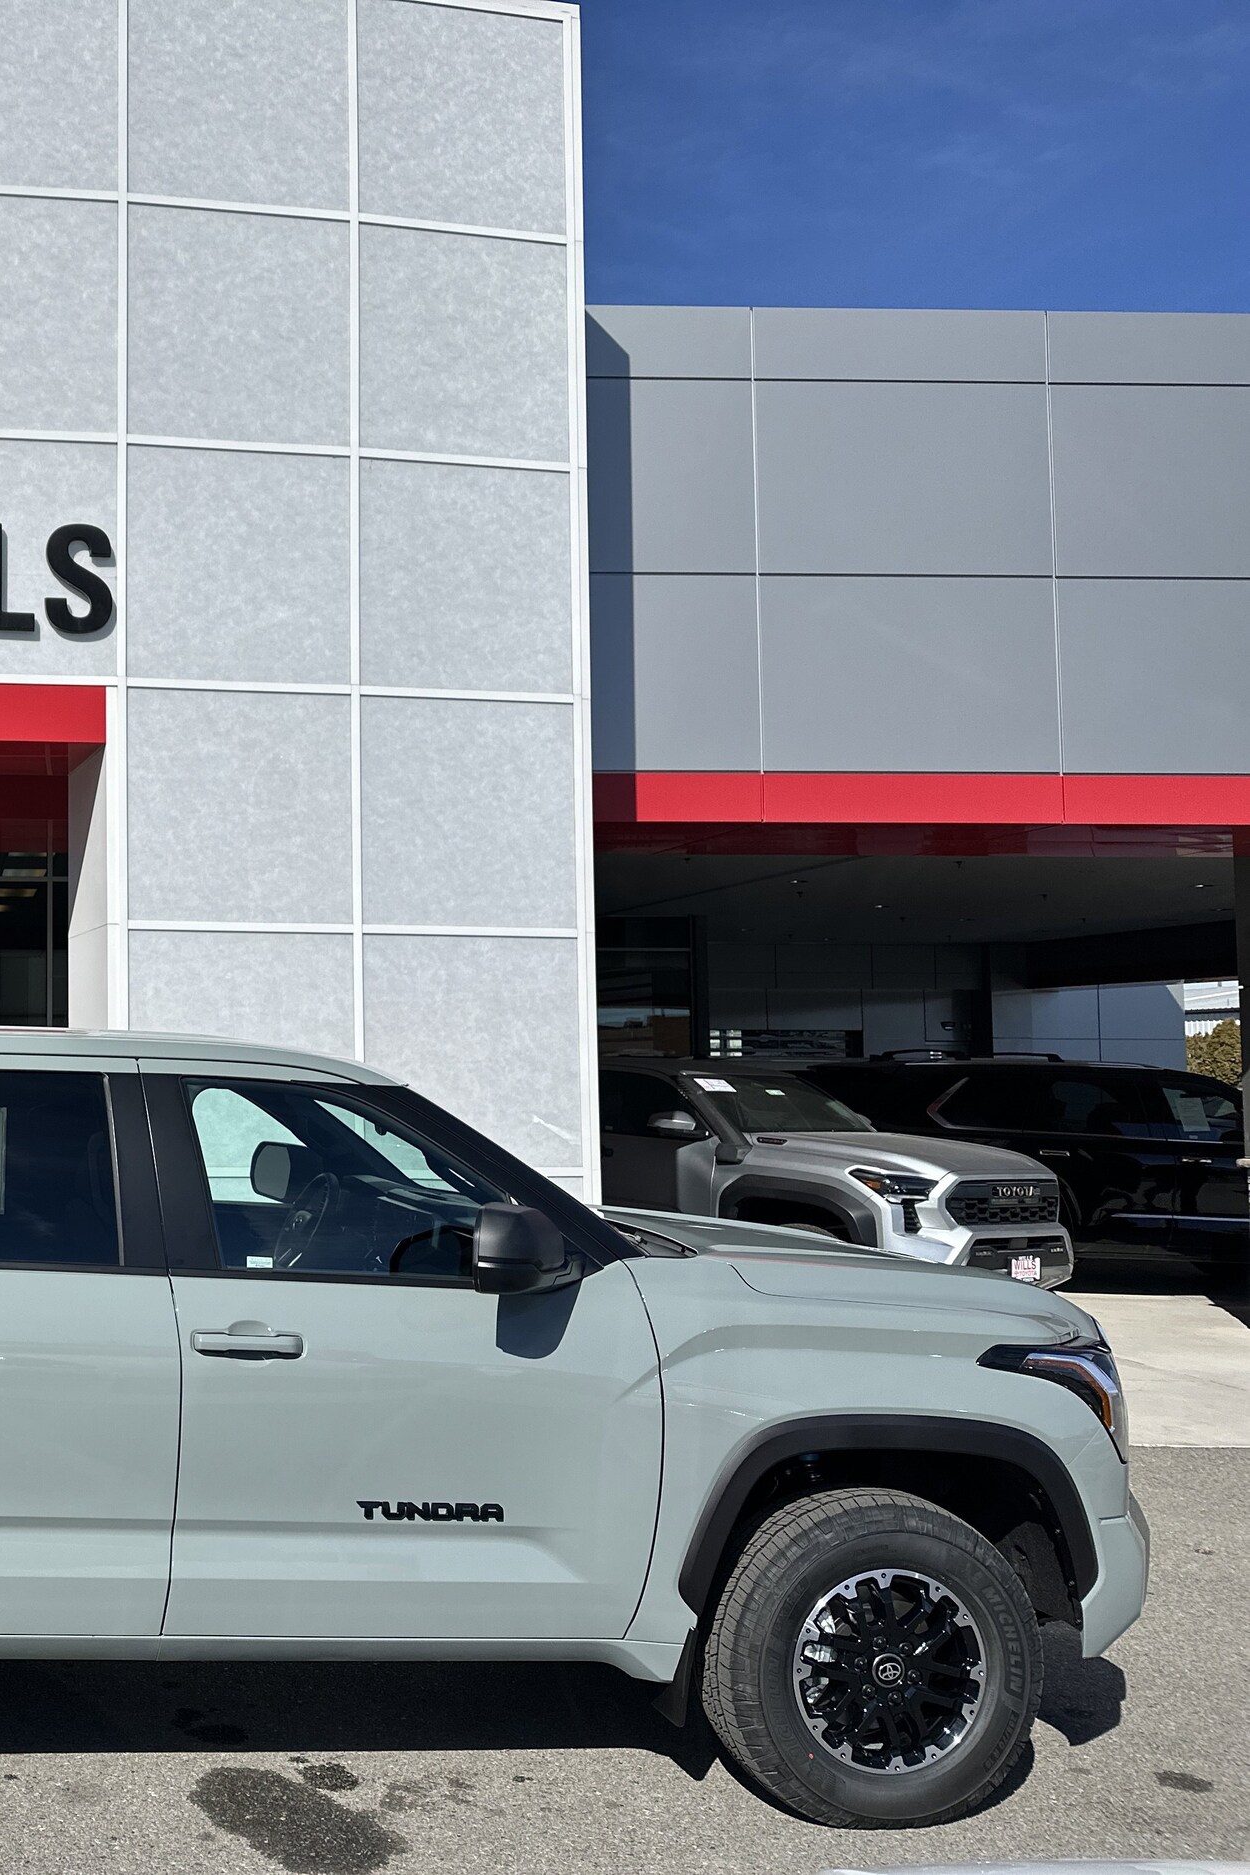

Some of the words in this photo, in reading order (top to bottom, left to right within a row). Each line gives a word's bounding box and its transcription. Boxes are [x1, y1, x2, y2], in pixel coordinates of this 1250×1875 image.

[997, 1186, 1035, 1197] TOYOTA
[1013, 1260, 1037, 1270] WILLS
[356, 1500, 504, 1522] TUNDRA
[981, 1585, 1023, 1693] MICHELIN
